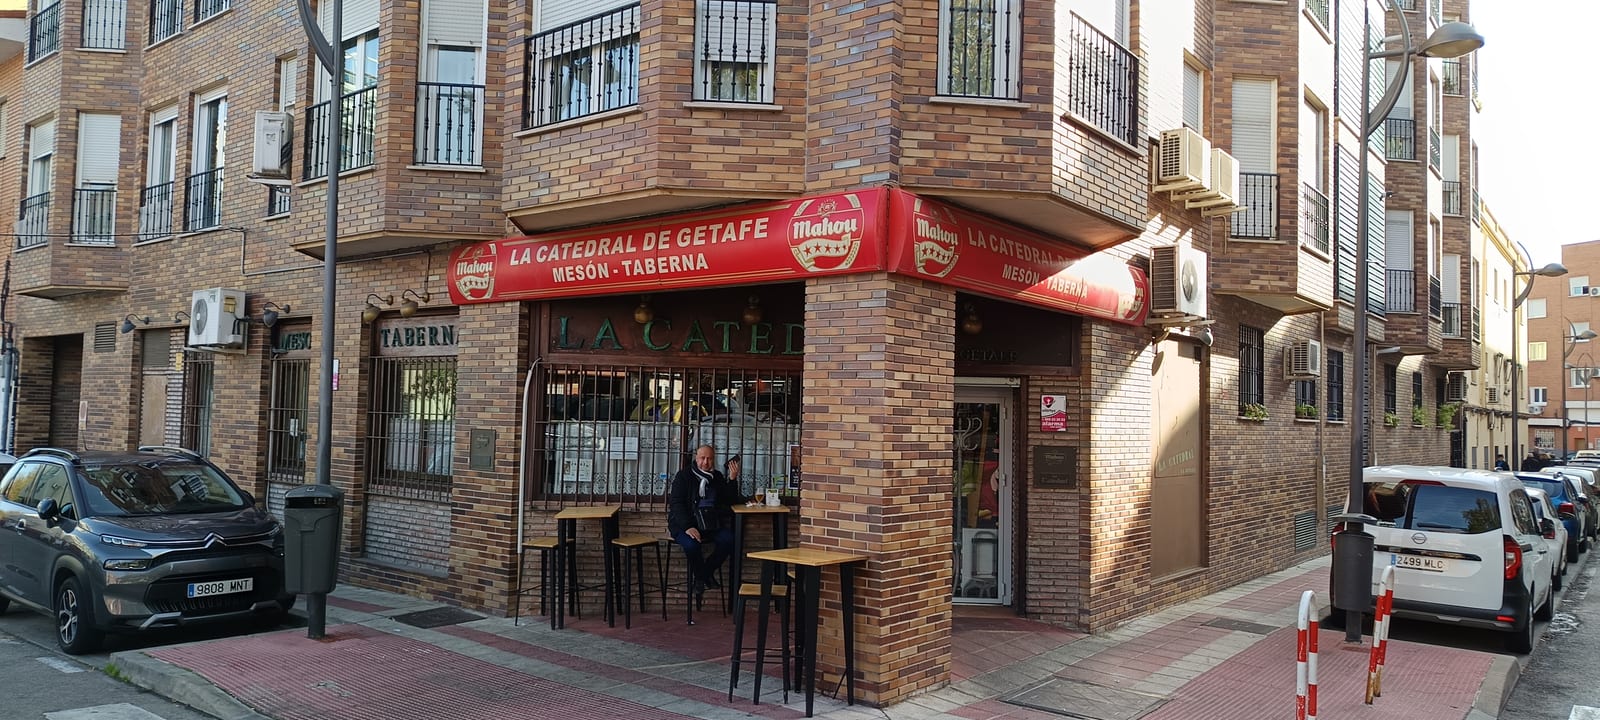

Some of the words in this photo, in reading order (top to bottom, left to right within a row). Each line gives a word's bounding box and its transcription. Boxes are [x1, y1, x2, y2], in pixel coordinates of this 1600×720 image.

[793, 217, 858, 240] Mahou
[916, 217, 958, 246] Mahou
[967, 227, 987, 249] LA
[510, 247, 531, 266] LA
[536, 235, 637, 263] CATEDRAL
[642, 229, 671, 252] DE
[676, 217, 769, 248] GETAFE
[456, 259, 493, 276] Mahou
[552, 261, 610, 283] MESÓN
[621, 253, 709, 277] TABERNA
[1002, 264, 1040, 286] MESÓN
[1046, 276, 1088, 299] TABERNA
[380, 325, 459, 348] TABERN
[557, 316, 624, 351] LA
[1397, 556, 1421, 567] 2499
[1424, 559, 1444, 569] MLC
[197, 583, 224, 595] 9808
[230, 579, 249, 592] MNT
